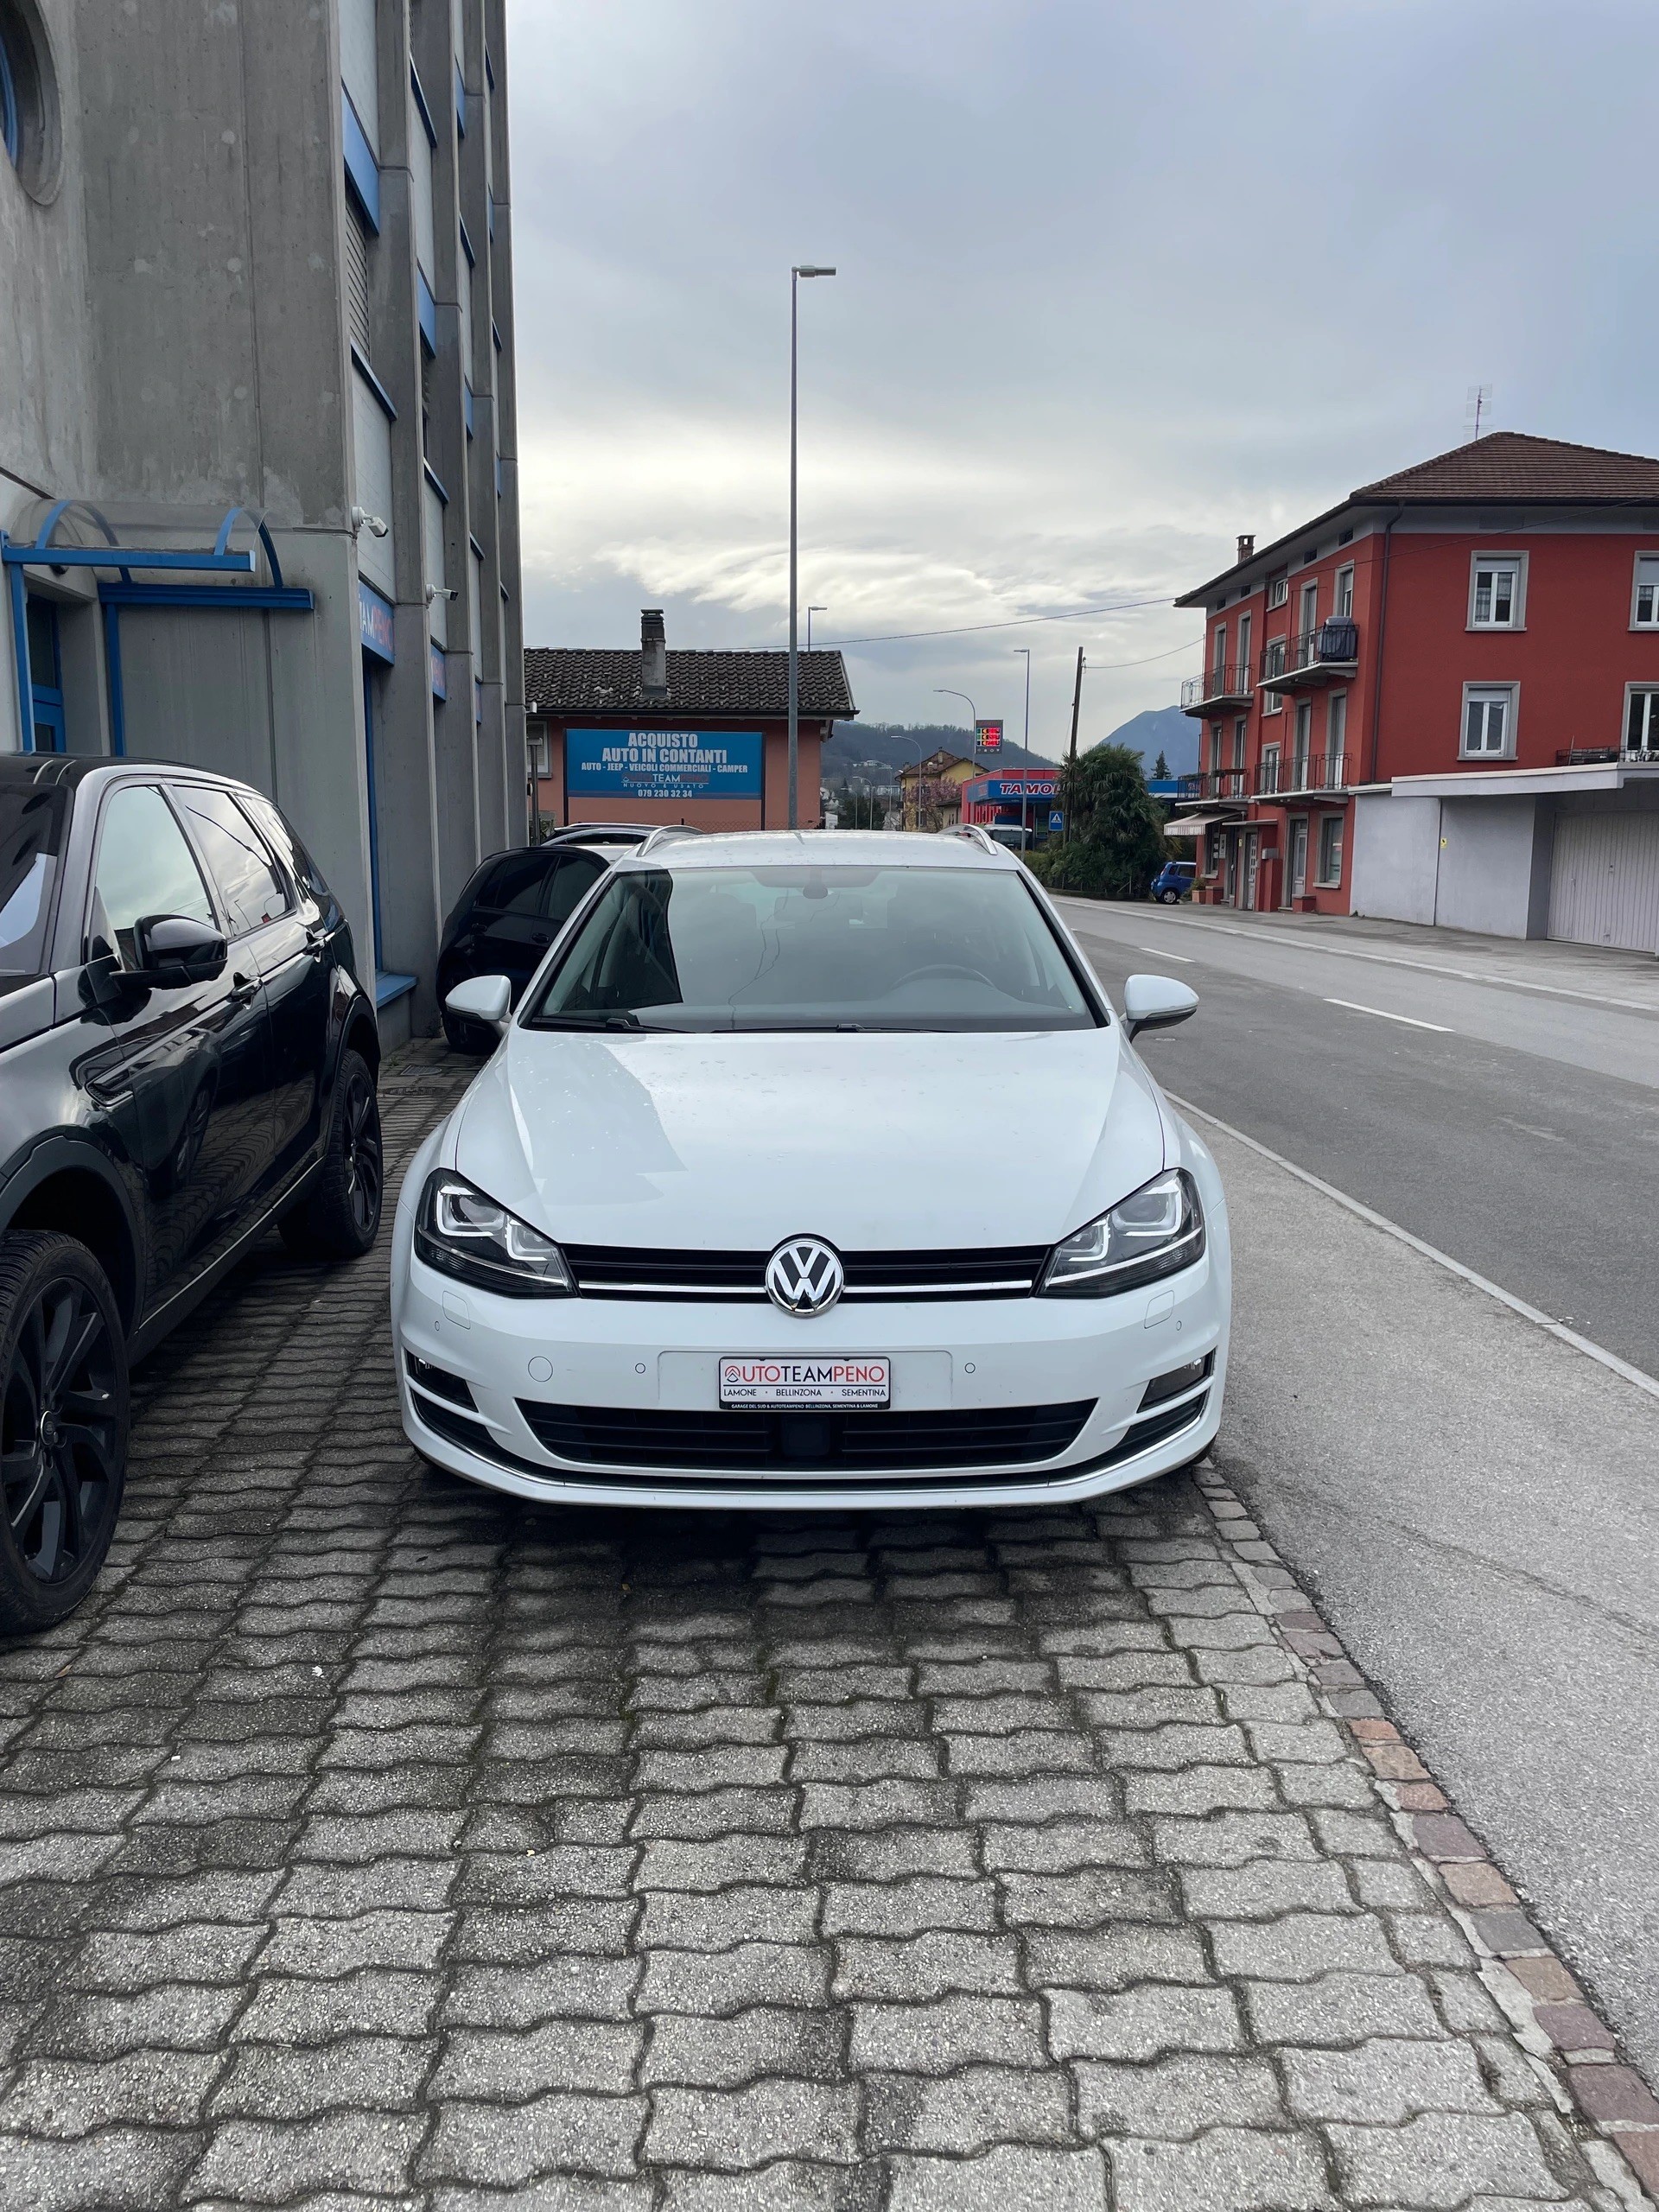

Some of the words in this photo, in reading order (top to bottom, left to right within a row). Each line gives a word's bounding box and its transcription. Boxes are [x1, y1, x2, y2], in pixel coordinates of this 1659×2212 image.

[628, 732, 698, 749] ACQUISTO
[601, 747, 639, 762] AUTO
[641, 748, 657, 762] IN
[659, 748, 728, 764] CONTANTI
[581, 762, 602, 771] AUTO
[607, 762, 624, 772] JEEP
[629, 763, 658, 772] VEICOLI
[659, 764, 712, 773] COMMERCIALI
[716, 765, 748, 773] CAMPER
[638, 789, 652, 798] 079
[653, 789, 670, 798] 230
